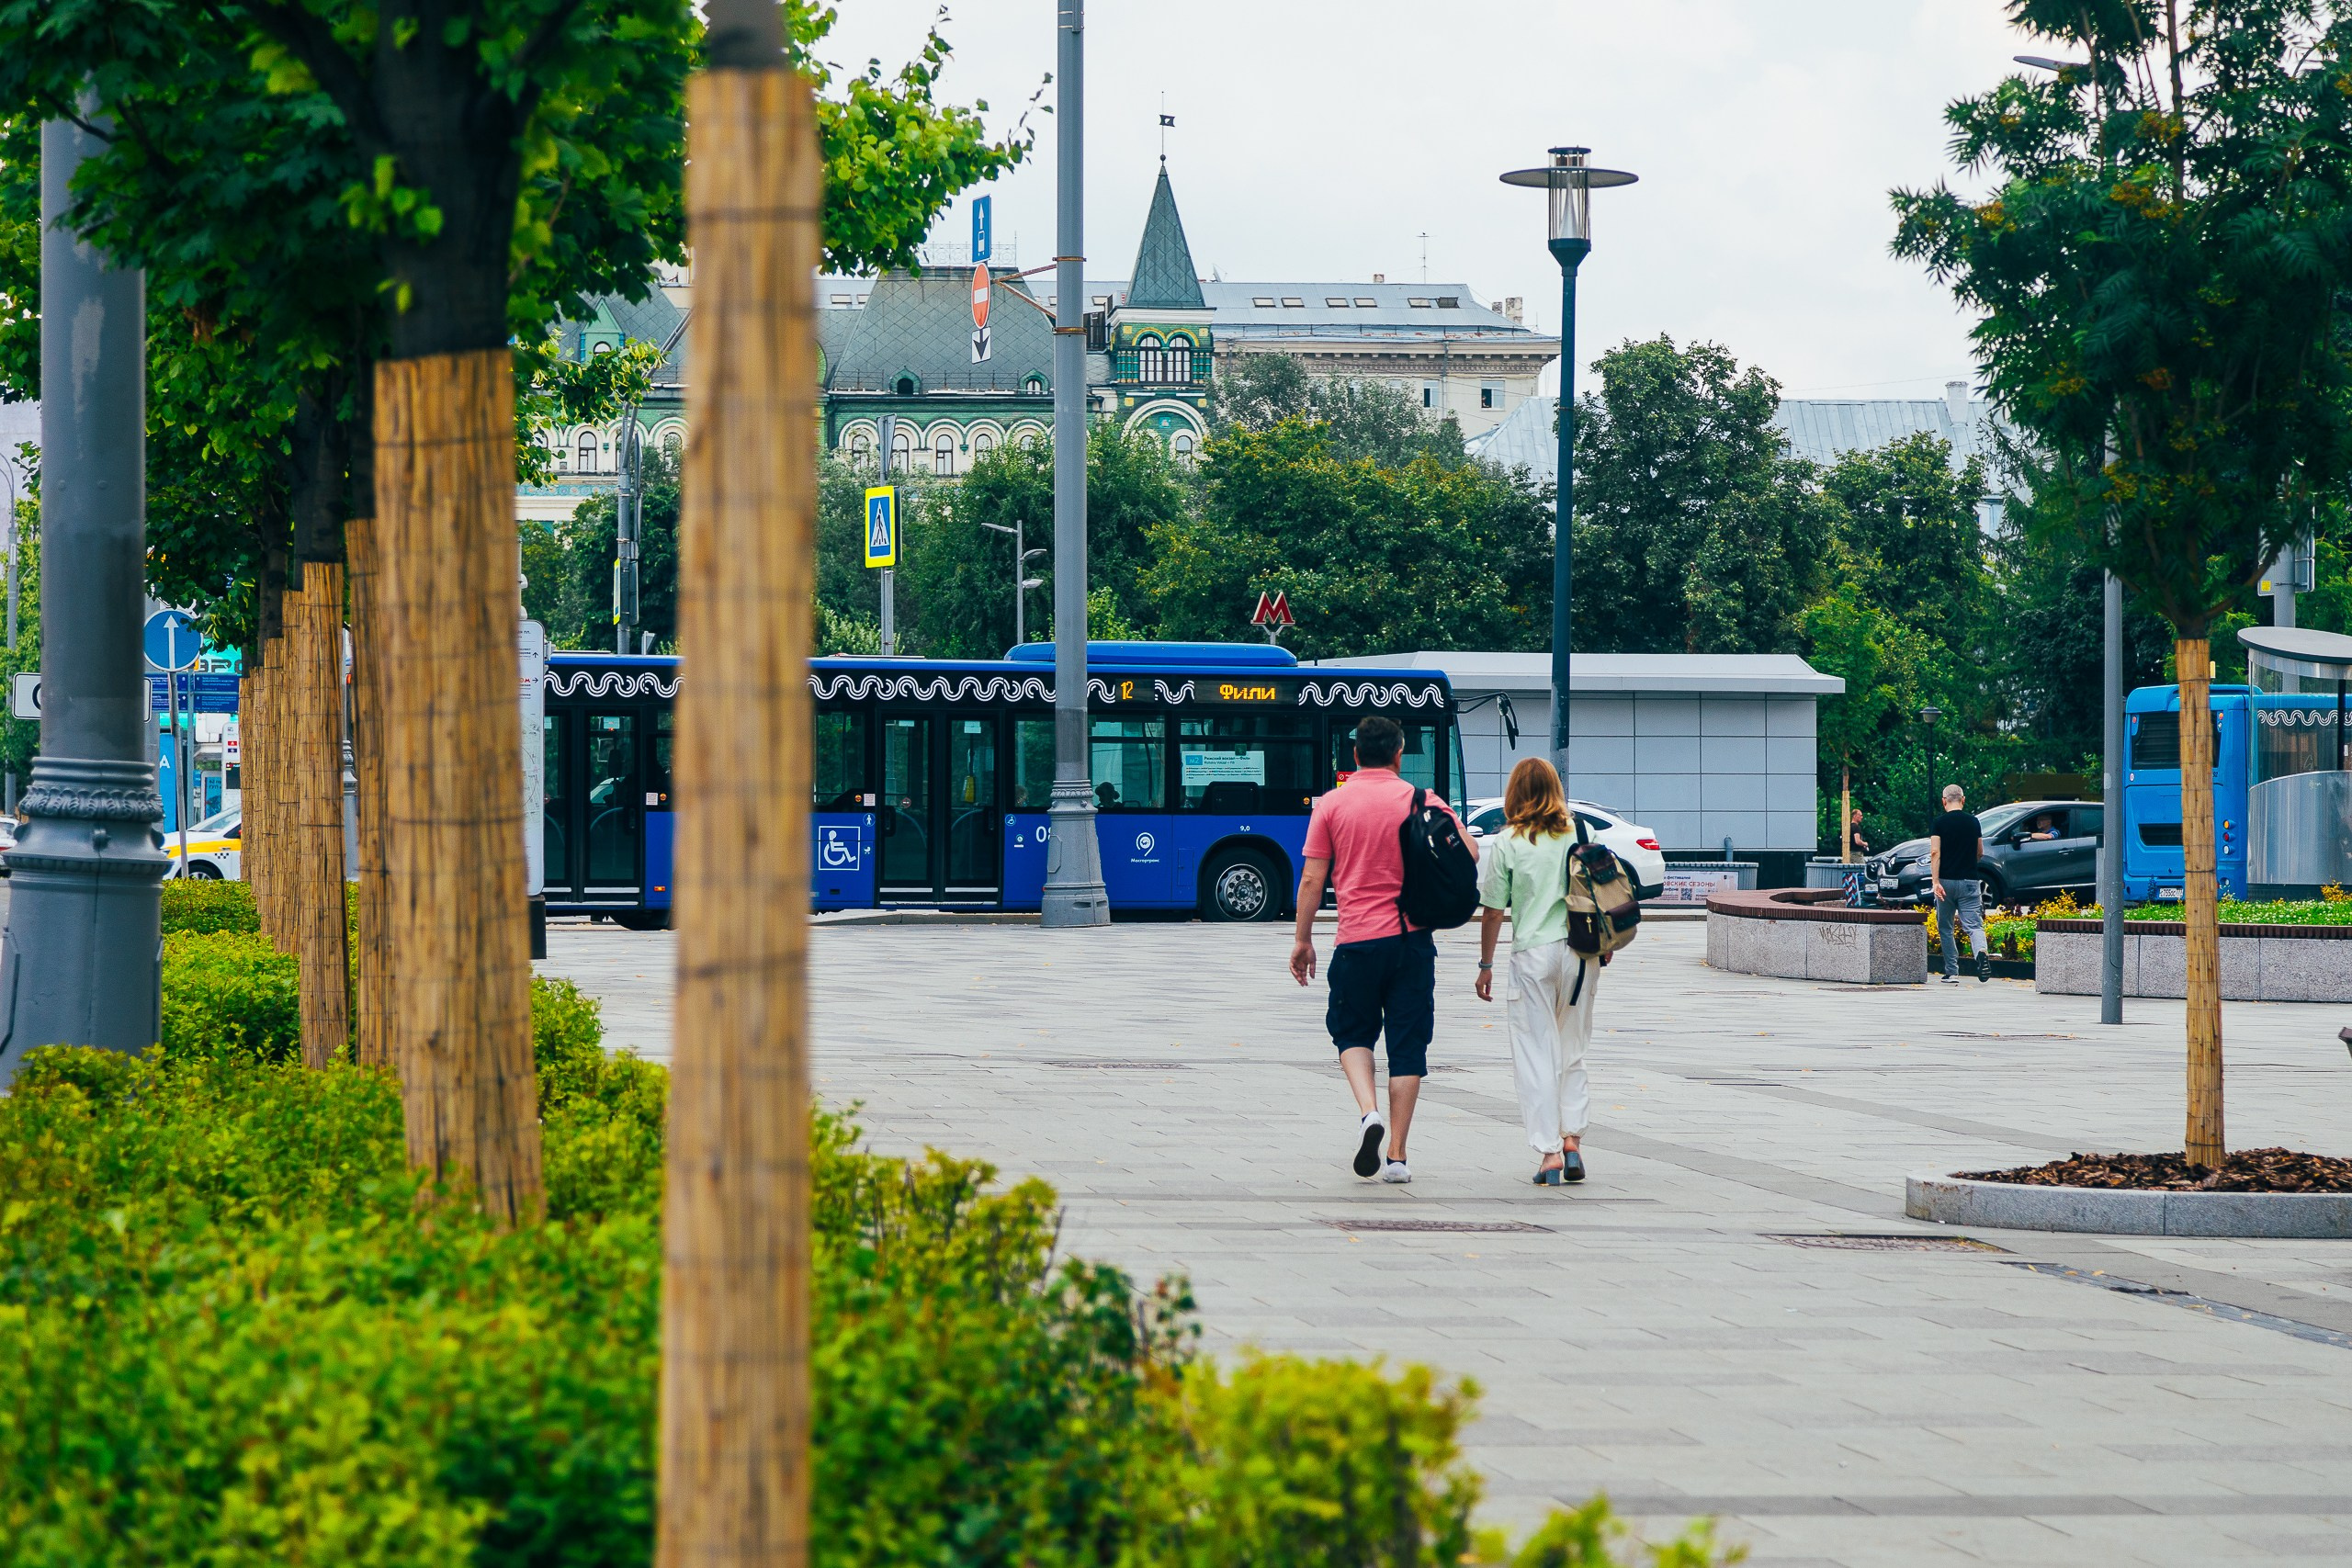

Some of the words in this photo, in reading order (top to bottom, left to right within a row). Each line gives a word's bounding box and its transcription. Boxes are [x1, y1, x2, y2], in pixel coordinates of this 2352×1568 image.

[1250, 591, 1295, 625] М
[1120, 681, 1134, 700] 12
[1219, 683, 1275, 700] Фили
